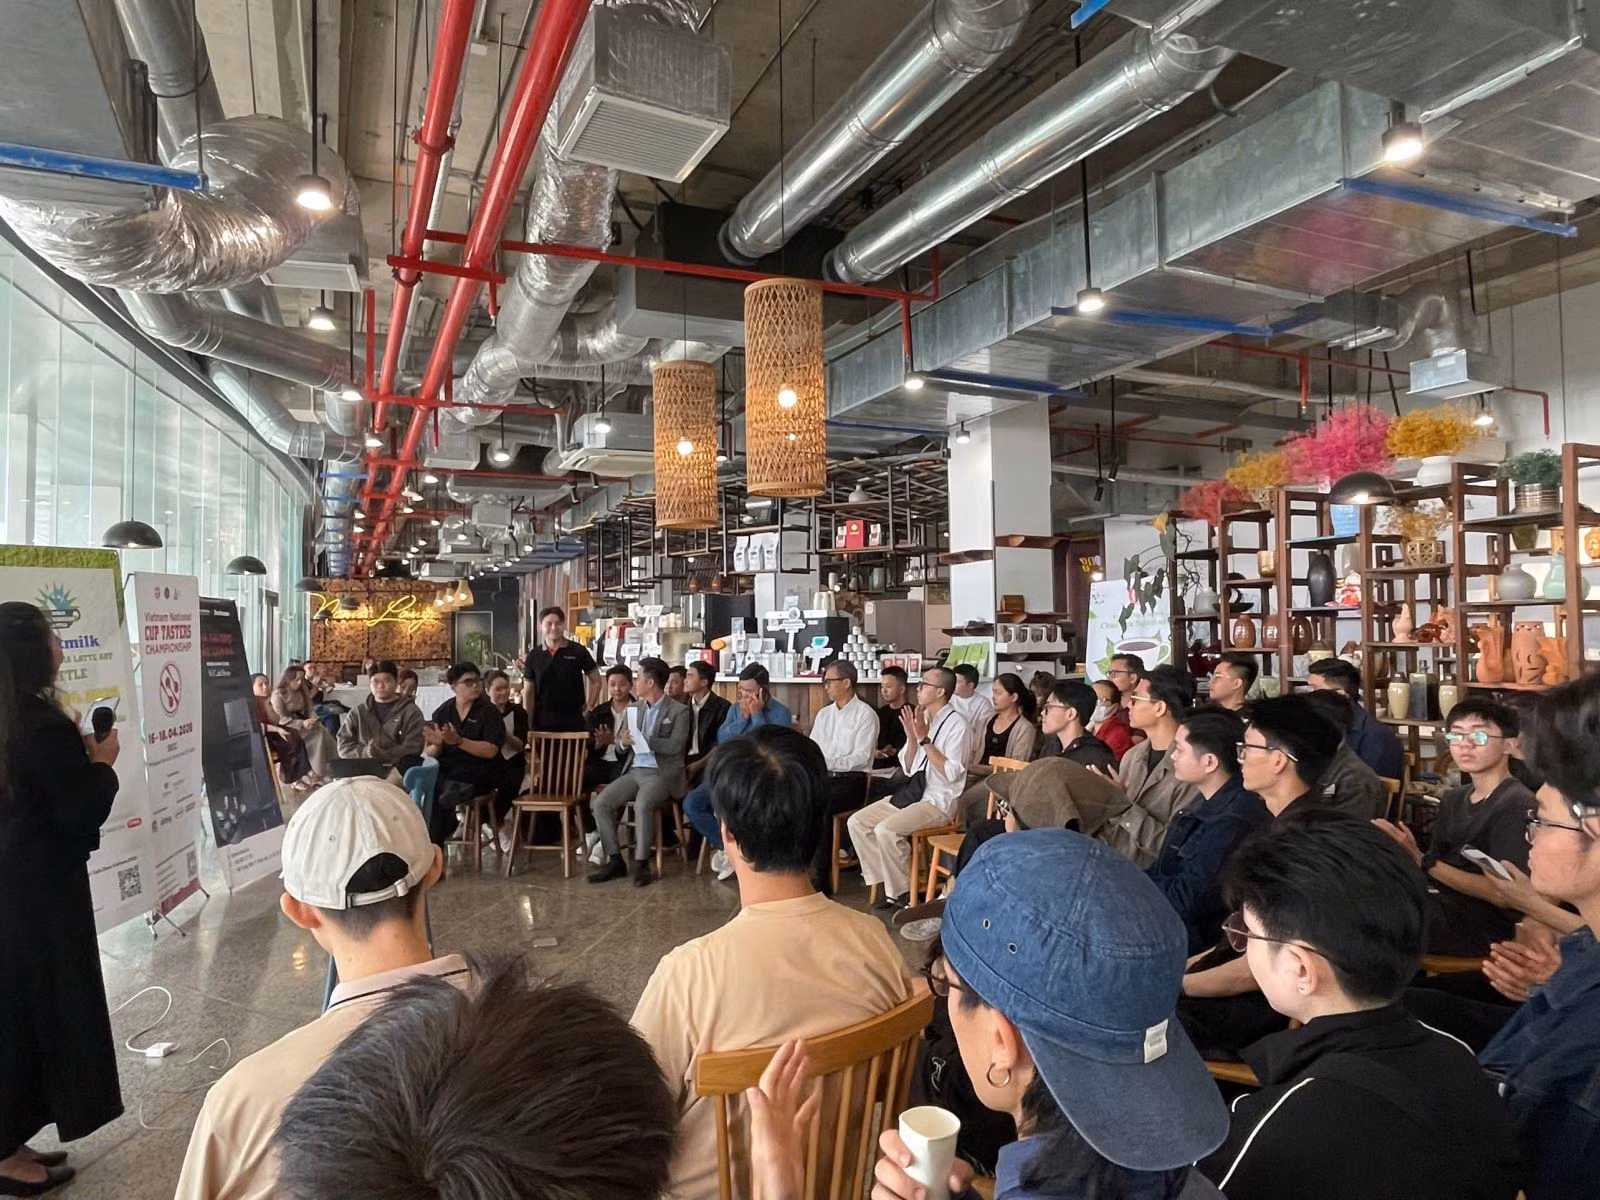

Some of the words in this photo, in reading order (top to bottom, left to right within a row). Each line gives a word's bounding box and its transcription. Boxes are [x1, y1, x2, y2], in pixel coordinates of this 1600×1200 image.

[144, 611, 169, 622] Vietnam
[145, 625, 160, 641] CUP
[161, 624, 192, 640] TASTERS
[145, 642, 192, 655] CHAMPIONSHIP
[73, 653, 98, 663] LATTE
